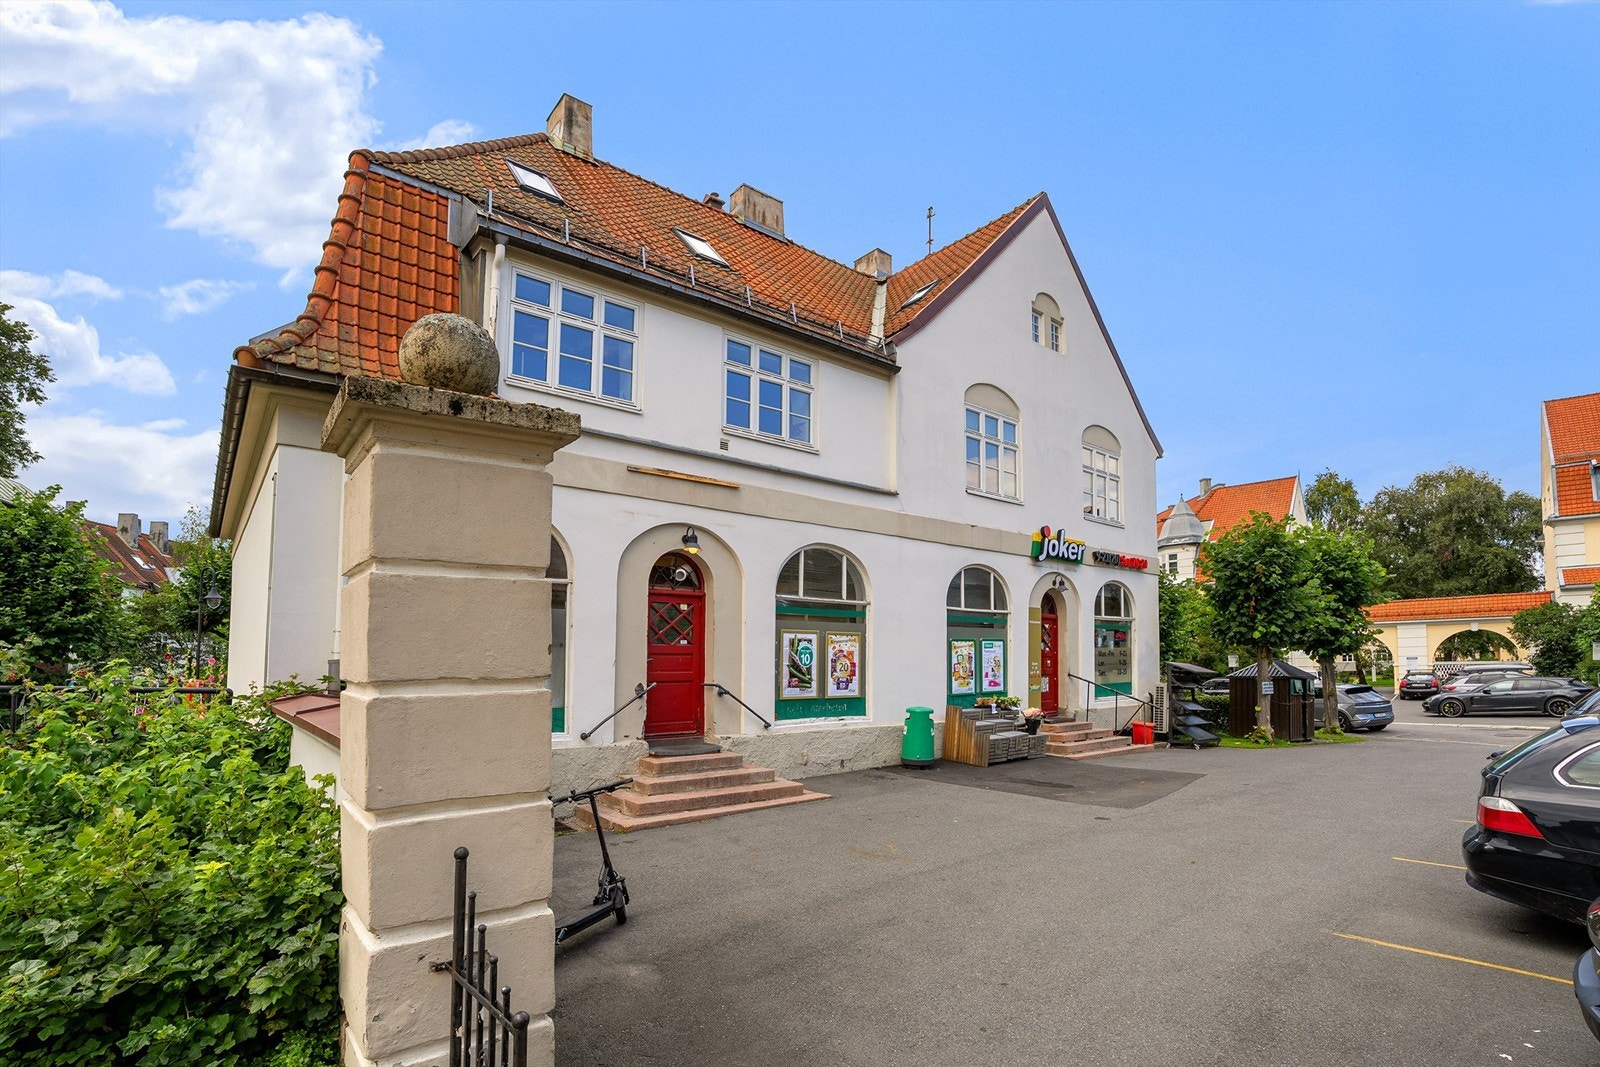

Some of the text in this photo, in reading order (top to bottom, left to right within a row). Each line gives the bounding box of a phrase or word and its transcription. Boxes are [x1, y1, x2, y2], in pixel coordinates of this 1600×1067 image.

[1038, 525, 1086, 562] joker
[800, 654, 810, 664] 10
[838, 662, 849, 672] 20
